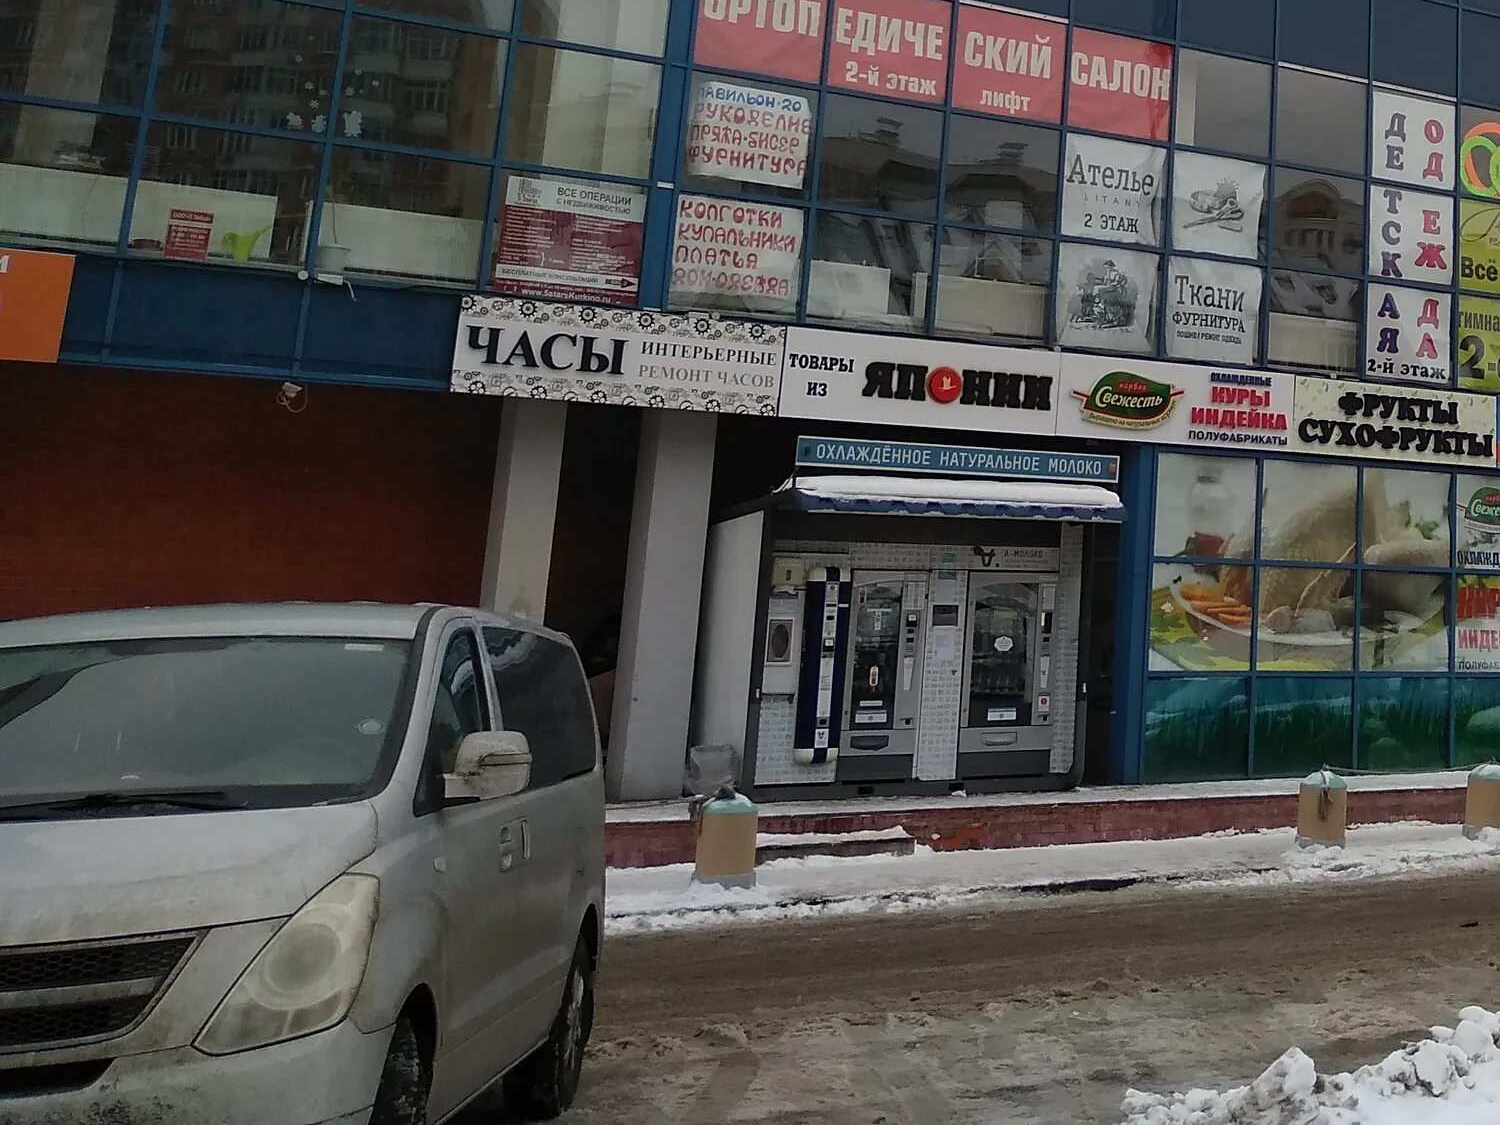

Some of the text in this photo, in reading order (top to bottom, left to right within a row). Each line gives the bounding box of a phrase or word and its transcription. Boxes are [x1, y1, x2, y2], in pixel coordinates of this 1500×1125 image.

[846, 61, 936, 96] 2-й этаж
[1071, 52, 1171, 101] САЛОН
[980, 90, 1030, 114] лифт
[1066, 154, 1154, 196] Ателье
[557, 186, 632, 206] ВСЕ ОПЕРАЦИИ
[563, 199, 631, 215] НЕДВИЖИМОСТЬЮ
[1084, 213, 1139, 234] 2 ЭТАЖ
[677, 222, 797, 253] КУПАЛЬНИКИ
[675, 245, 758, 270] ПЛАТЬЯ
[1461, 256, 1498, 282] Всё
[1174, 274, 1245, 313] Ткани
[1172, 311, 1246, 334] ФУРНИТУРА
[465, 324, 777, 376] ЧАСЫ ИНТЕРЬЕРНЫЕ
[789, 353, 855, 374] ТОВАРЫ
[1367, 357, 1447, 380] 2-й этаж
[638, 364, 775, 388] РЕМОНТ ЧАСОВ
[1210, 371, 1272, 387] ОХЛАЖДЕННЫЕ
[806, 381, 829, 398] ИЗ
[1095, 386, 1163, 408] Свежесть
[1211, 386, 1271, 408] КУРЫ
[1191, 407, 1288, 431] ИНДЕЙКА
[1338, 390, 1459, 425] ФРУКТЫ
[1188, 430, 1288, 446] ПОЛУФАБРИКАТЫ
[1299, 418, 1494, 459] СУХОФРУКТЫ
[815, 442, 1102, 476] ОХЛАЖДЁННОЕ НАТУРАЛЬНОЕ МОЛОКО
